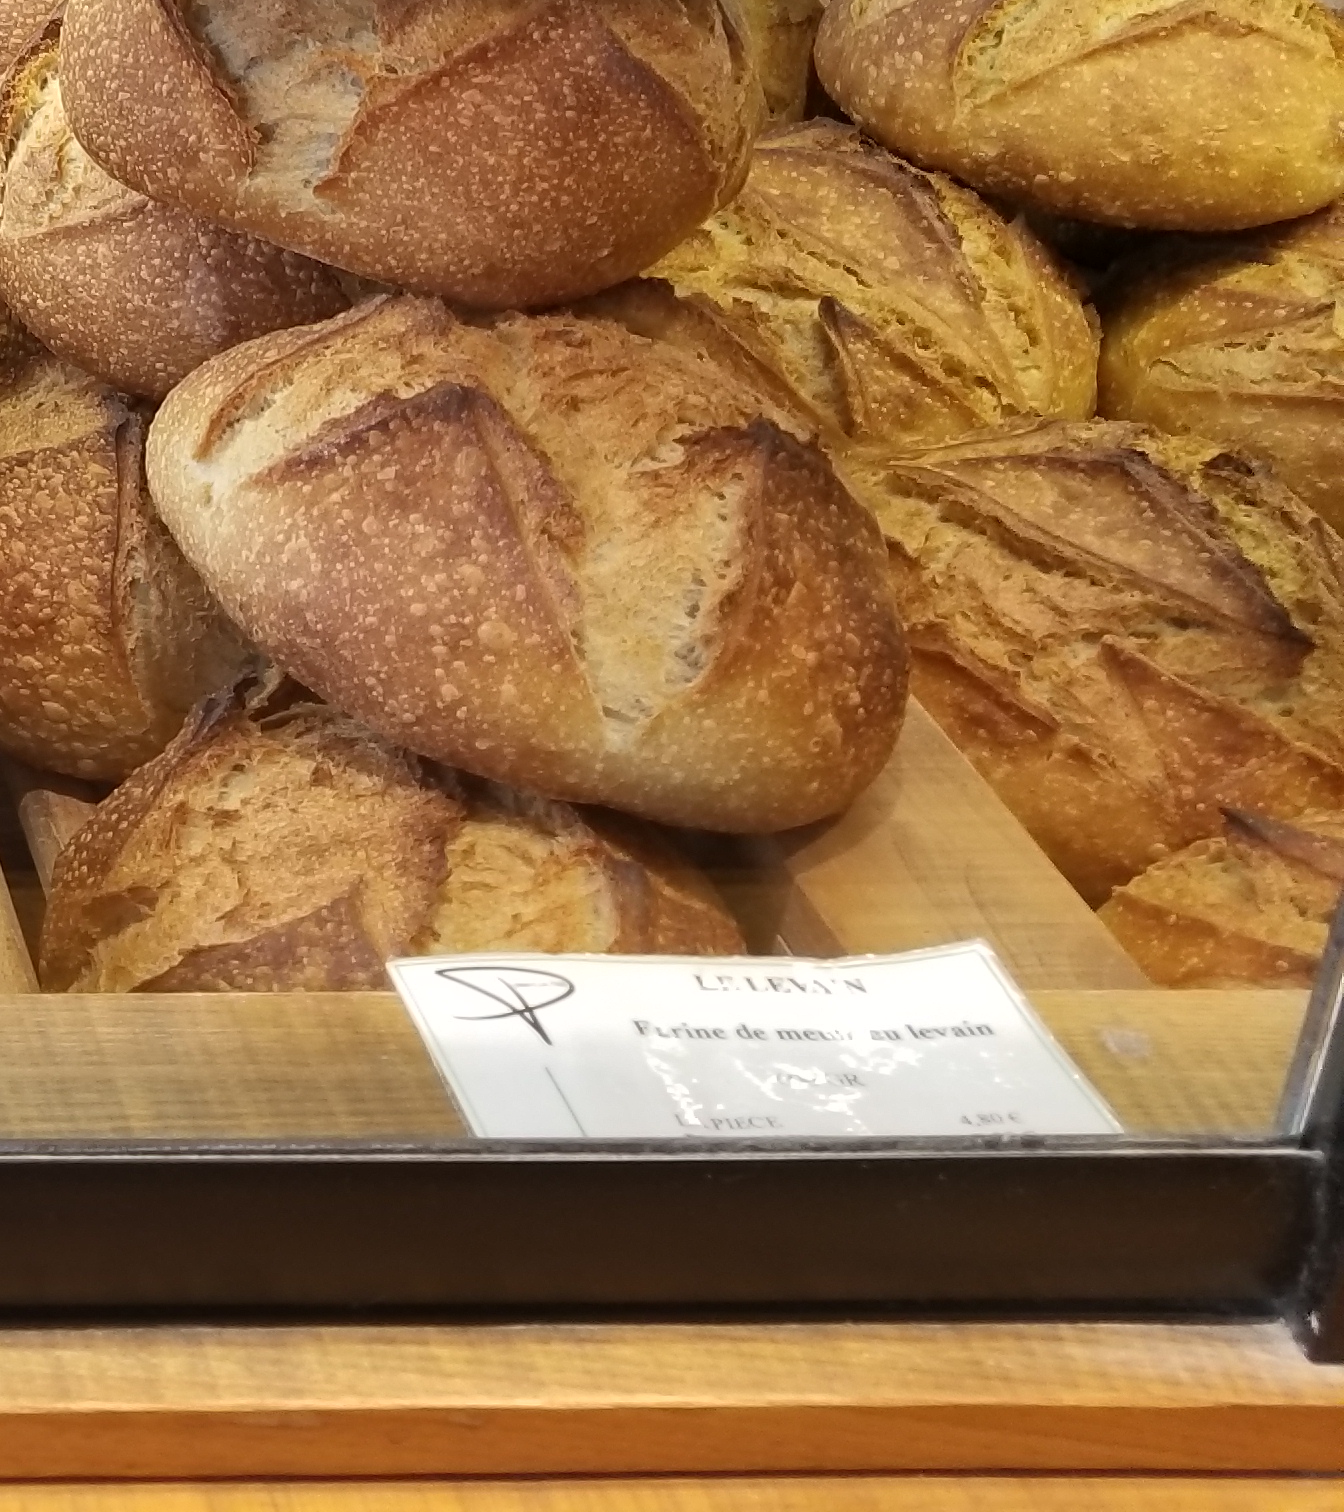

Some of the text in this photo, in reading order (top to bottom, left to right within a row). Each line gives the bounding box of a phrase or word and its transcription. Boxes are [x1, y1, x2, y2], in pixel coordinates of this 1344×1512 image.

[743, 977, 867, 995] LEVAN
[735, 1023, 767, 1041] de
[904, 1021, 996, 1040] levain
[710, 1116, 782, 1130] PIECE
